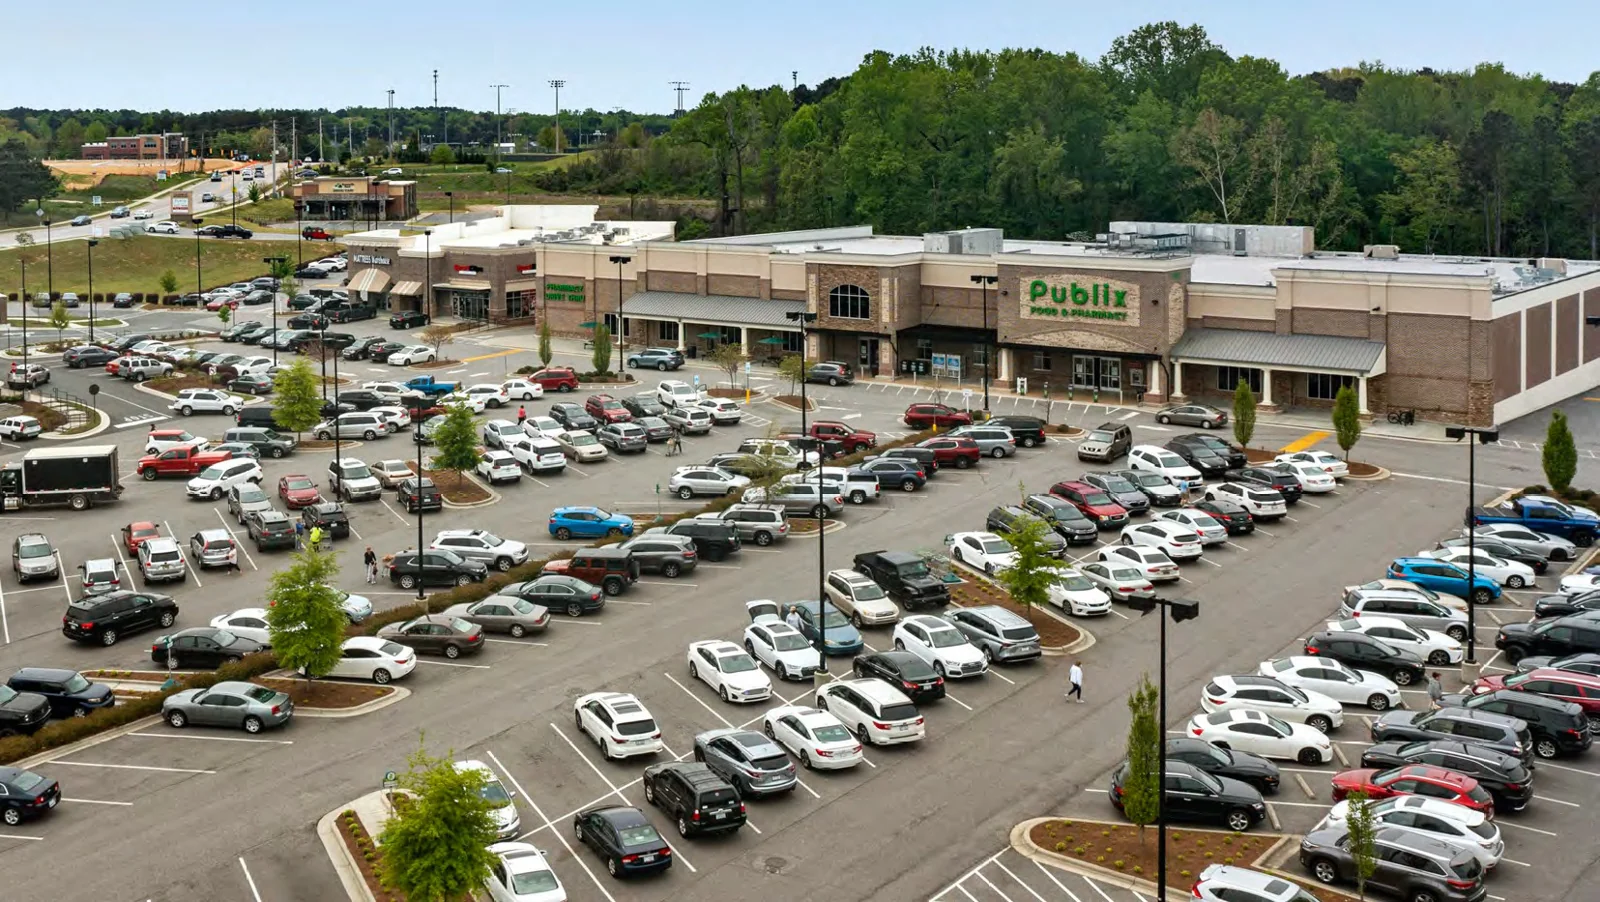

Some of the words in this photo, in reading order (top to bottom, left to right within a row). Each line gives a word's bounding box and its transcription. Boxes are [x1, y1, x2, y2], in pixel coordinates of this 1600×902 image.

[546, 283, 584, 292] PHARMACY
[1030, 280, 1127, 307] Publix
[545, 292, 565, 301] DRIVE
[568, 294, 586, 303] THRU
[1030, 306, 1058, 316] FOOD
[1061, 308, 1068, 317] &
[1070, 308, 1127, 320] PHARMACY
